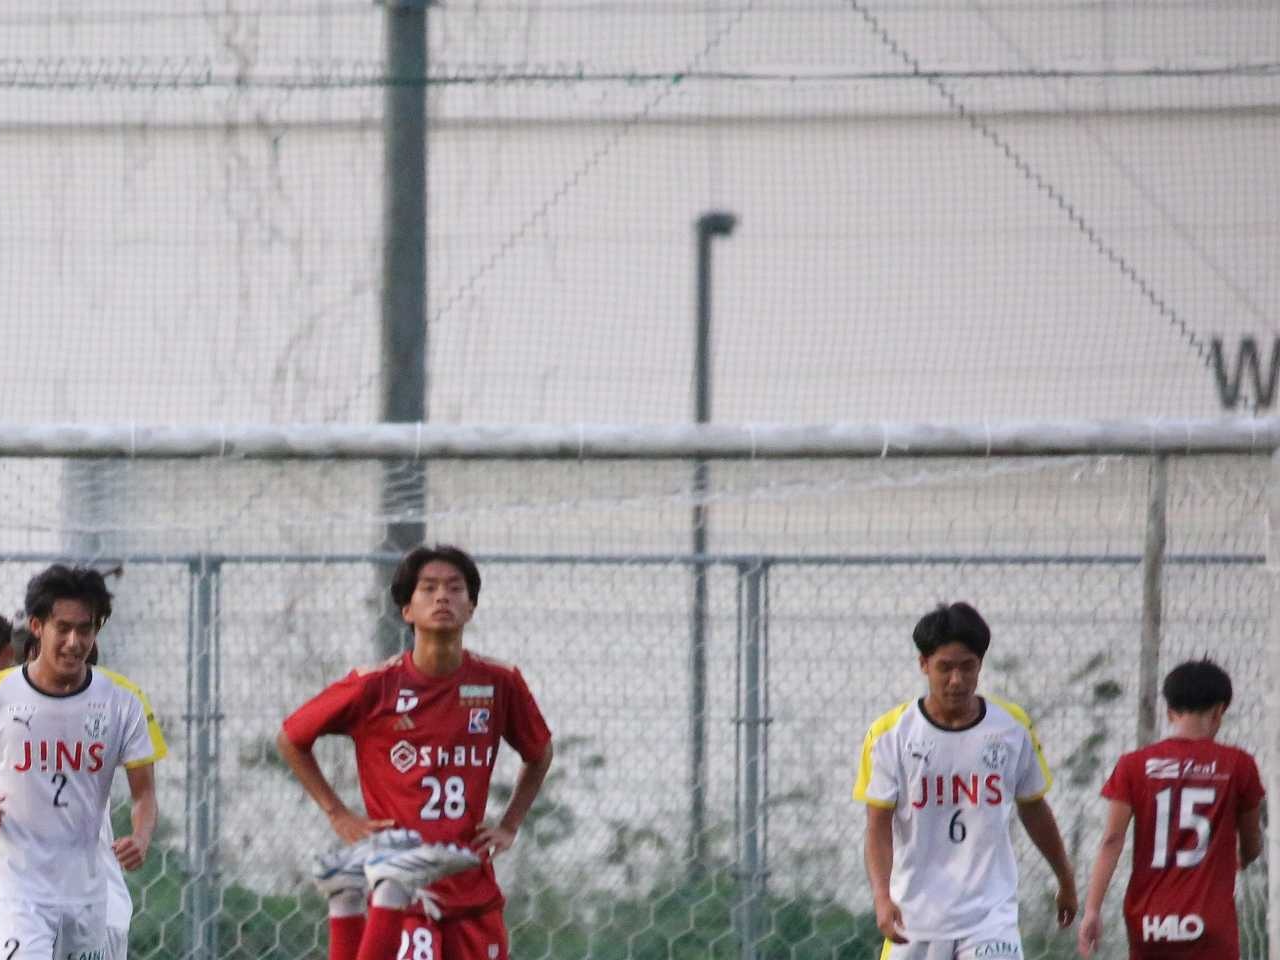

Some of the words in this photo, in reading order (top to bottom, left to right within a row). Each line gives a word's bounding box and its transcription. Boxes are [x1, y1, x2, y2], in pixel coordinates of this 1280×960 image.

[1210, 334, 1280, 411] W
[51, 773, 68, 808] 2
[420, 776, 466, 820] 28
[949, 809, 966, 844] 6
[1151, 786, 1217, 869] 15
